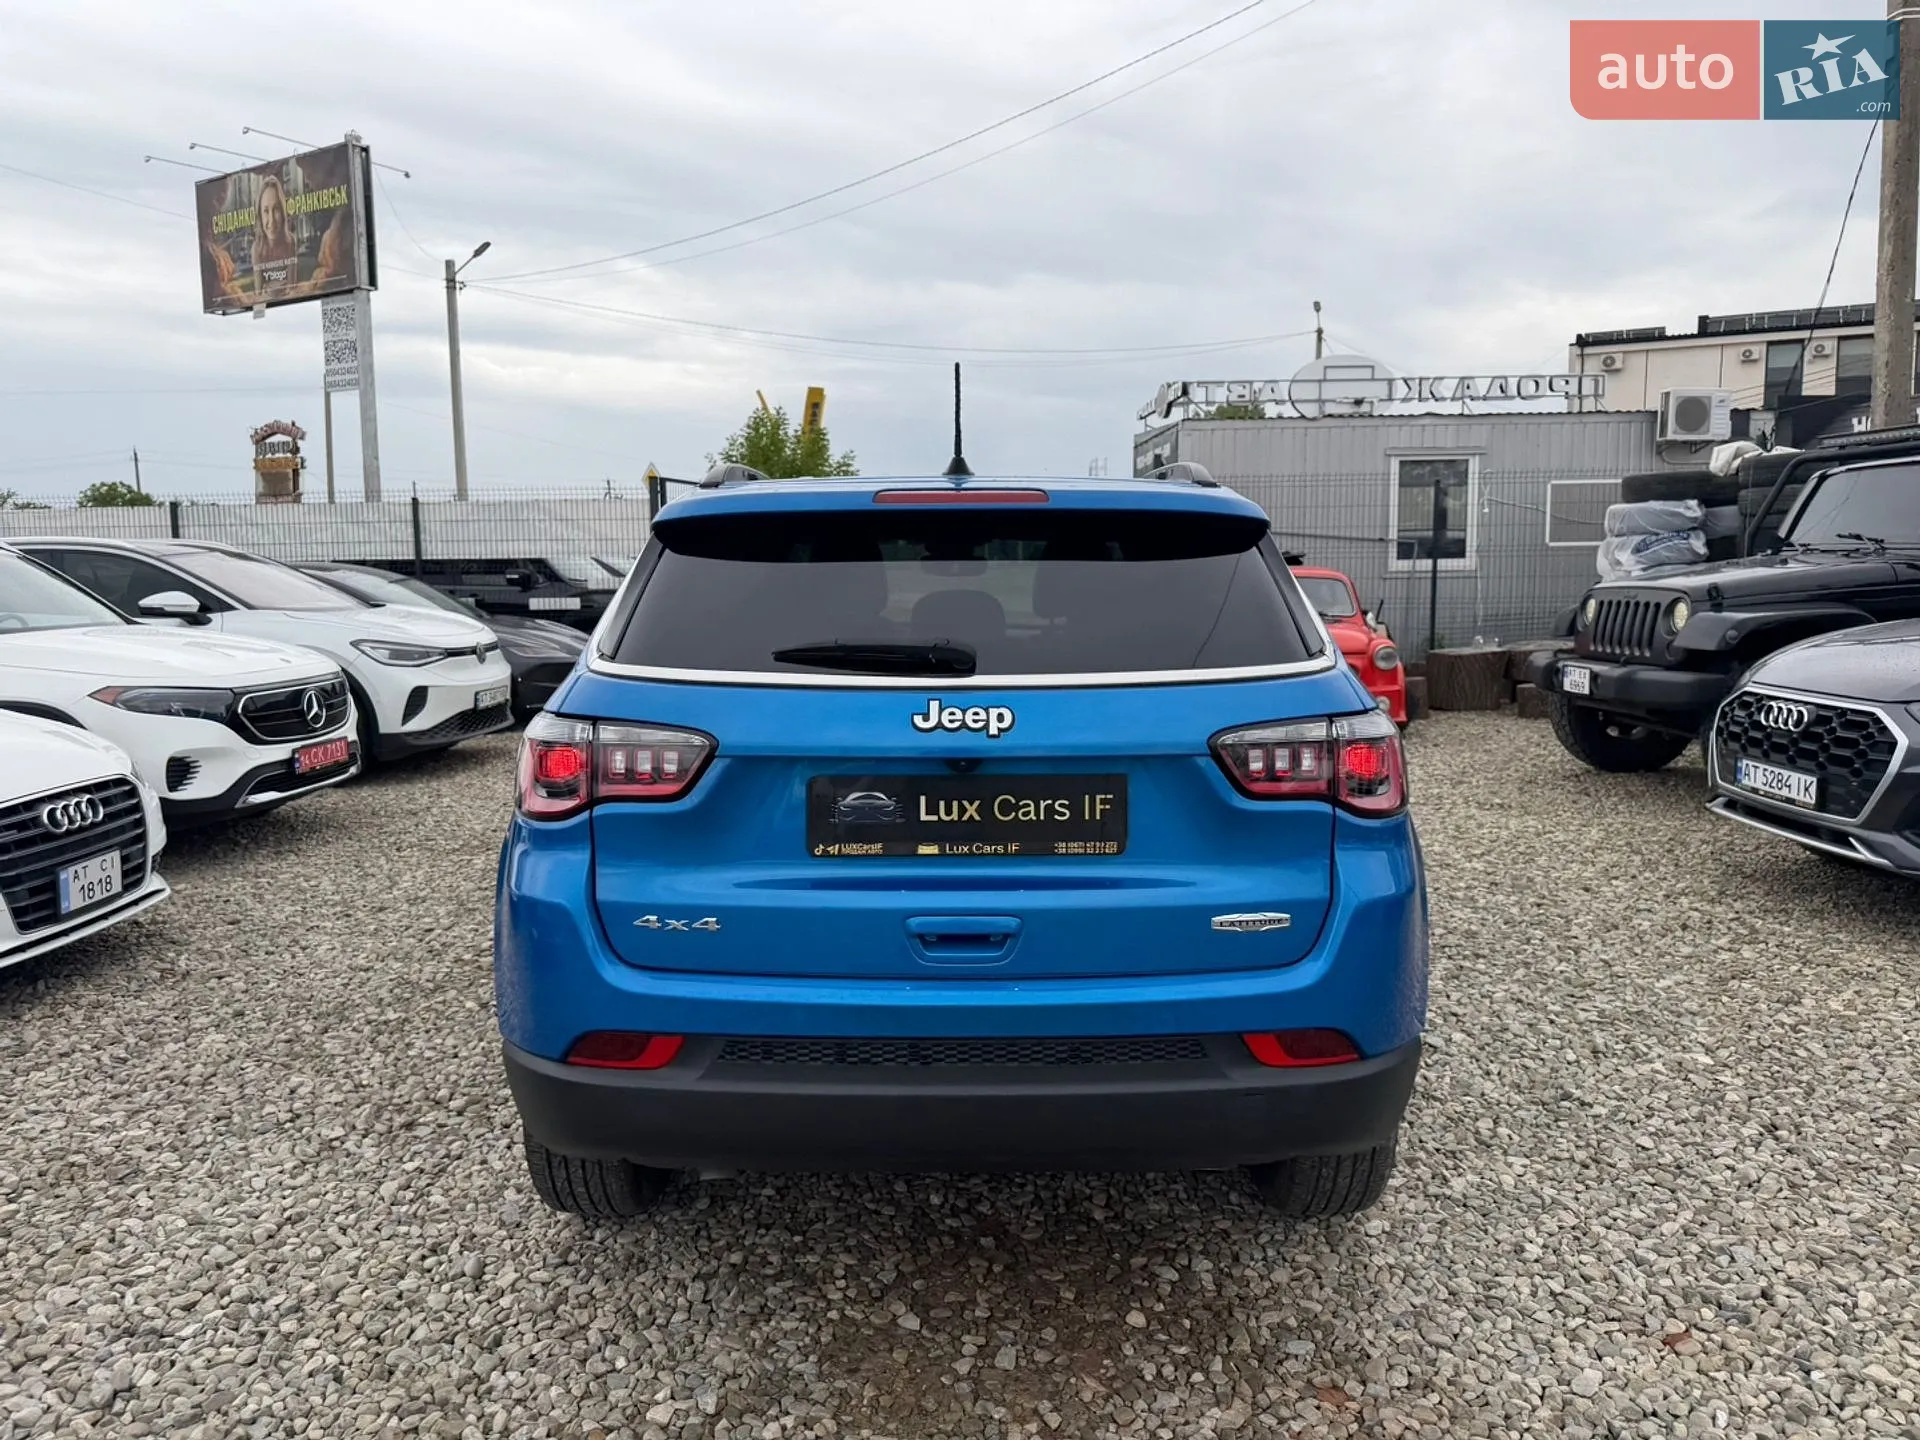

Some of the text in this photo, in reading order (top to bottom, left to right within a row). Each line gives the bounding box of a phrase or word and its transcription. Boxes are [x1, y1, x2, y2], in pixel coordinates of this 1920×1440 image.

[912, 698, 1014, 738] Jeep
[1743, 763, 1815, 801] AT 5284 IK
[919, 794, 1114, 821] Lux Cars IF
[945, 842, 1020, 854] Lux Cars IF
[72, 865, 89, 884] AT
[79, 874, 114, 902] 1818
